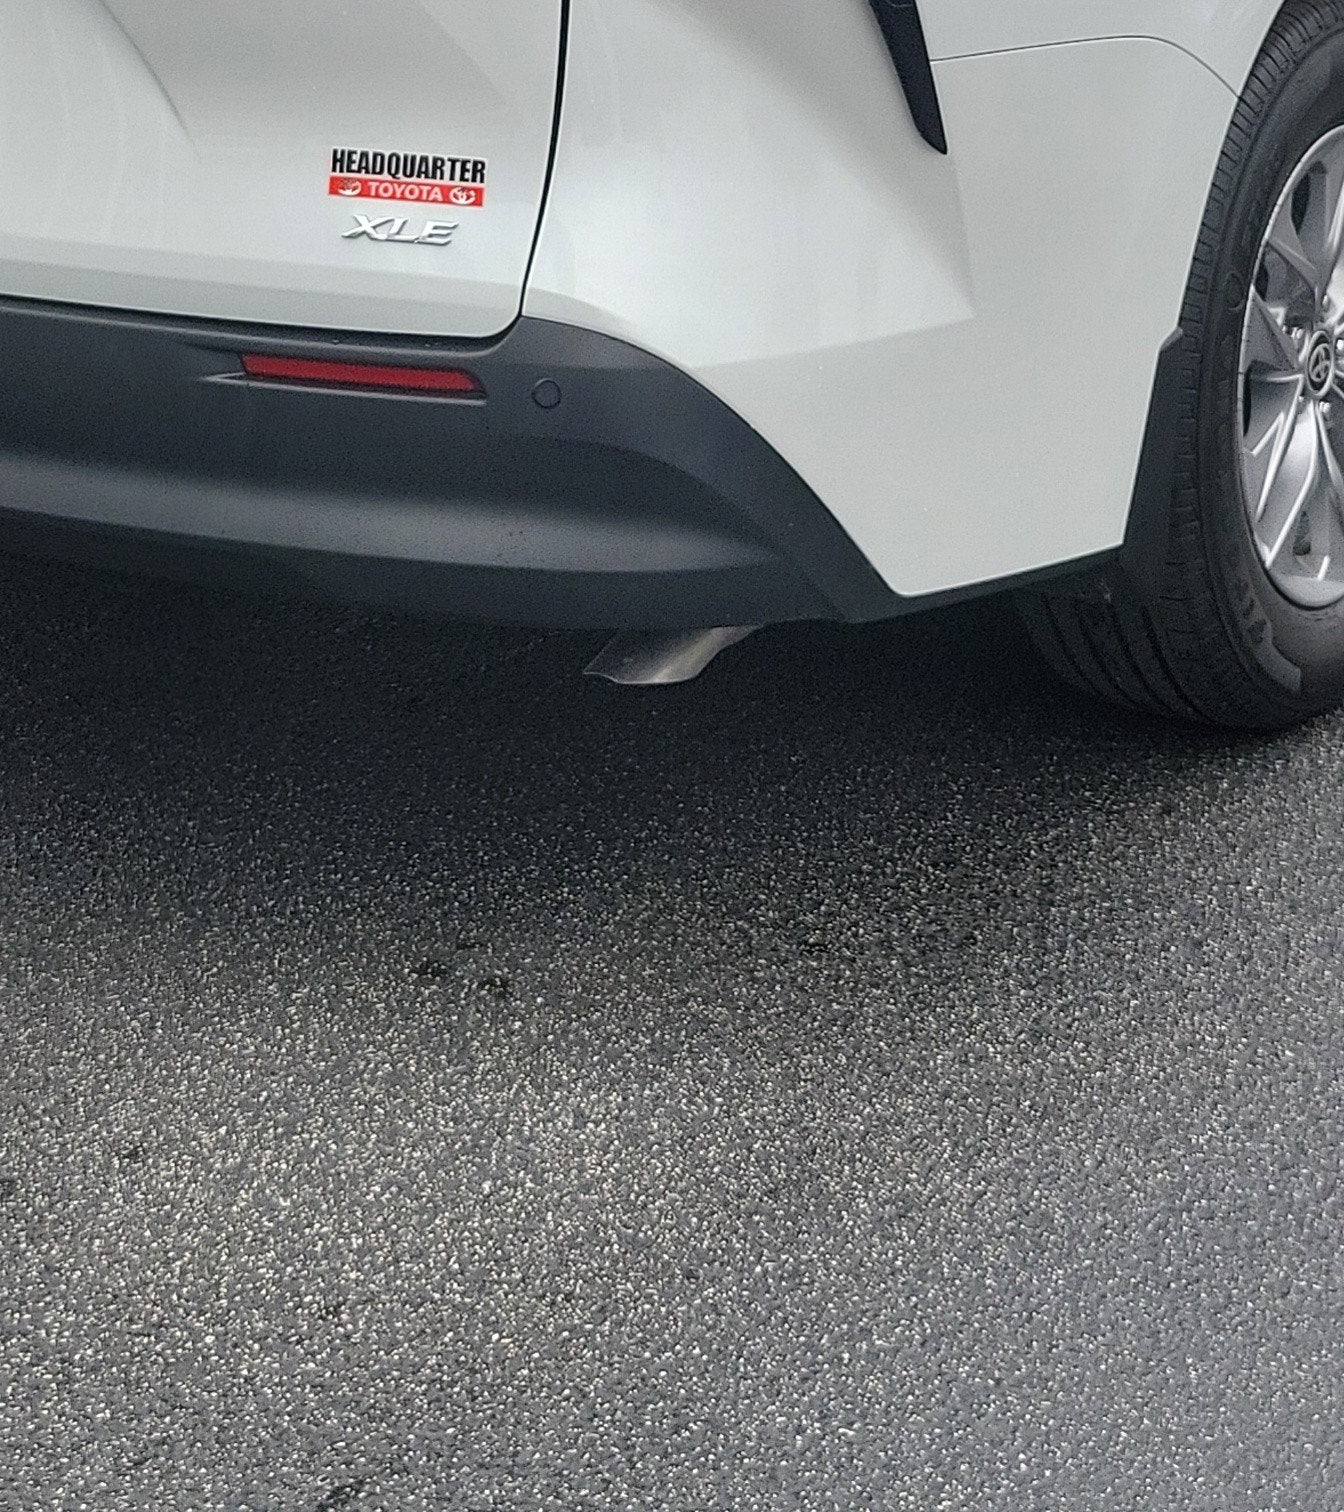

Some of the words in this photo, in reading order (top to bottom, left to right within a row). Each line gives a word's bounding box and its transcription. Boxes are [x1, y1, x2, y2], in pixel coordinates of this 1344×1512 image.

[331, 148, 486, 183] HEADQUARTER
[368, 181, 444, 202] TOYOTA
[341, 214, 459, 245] XLE
